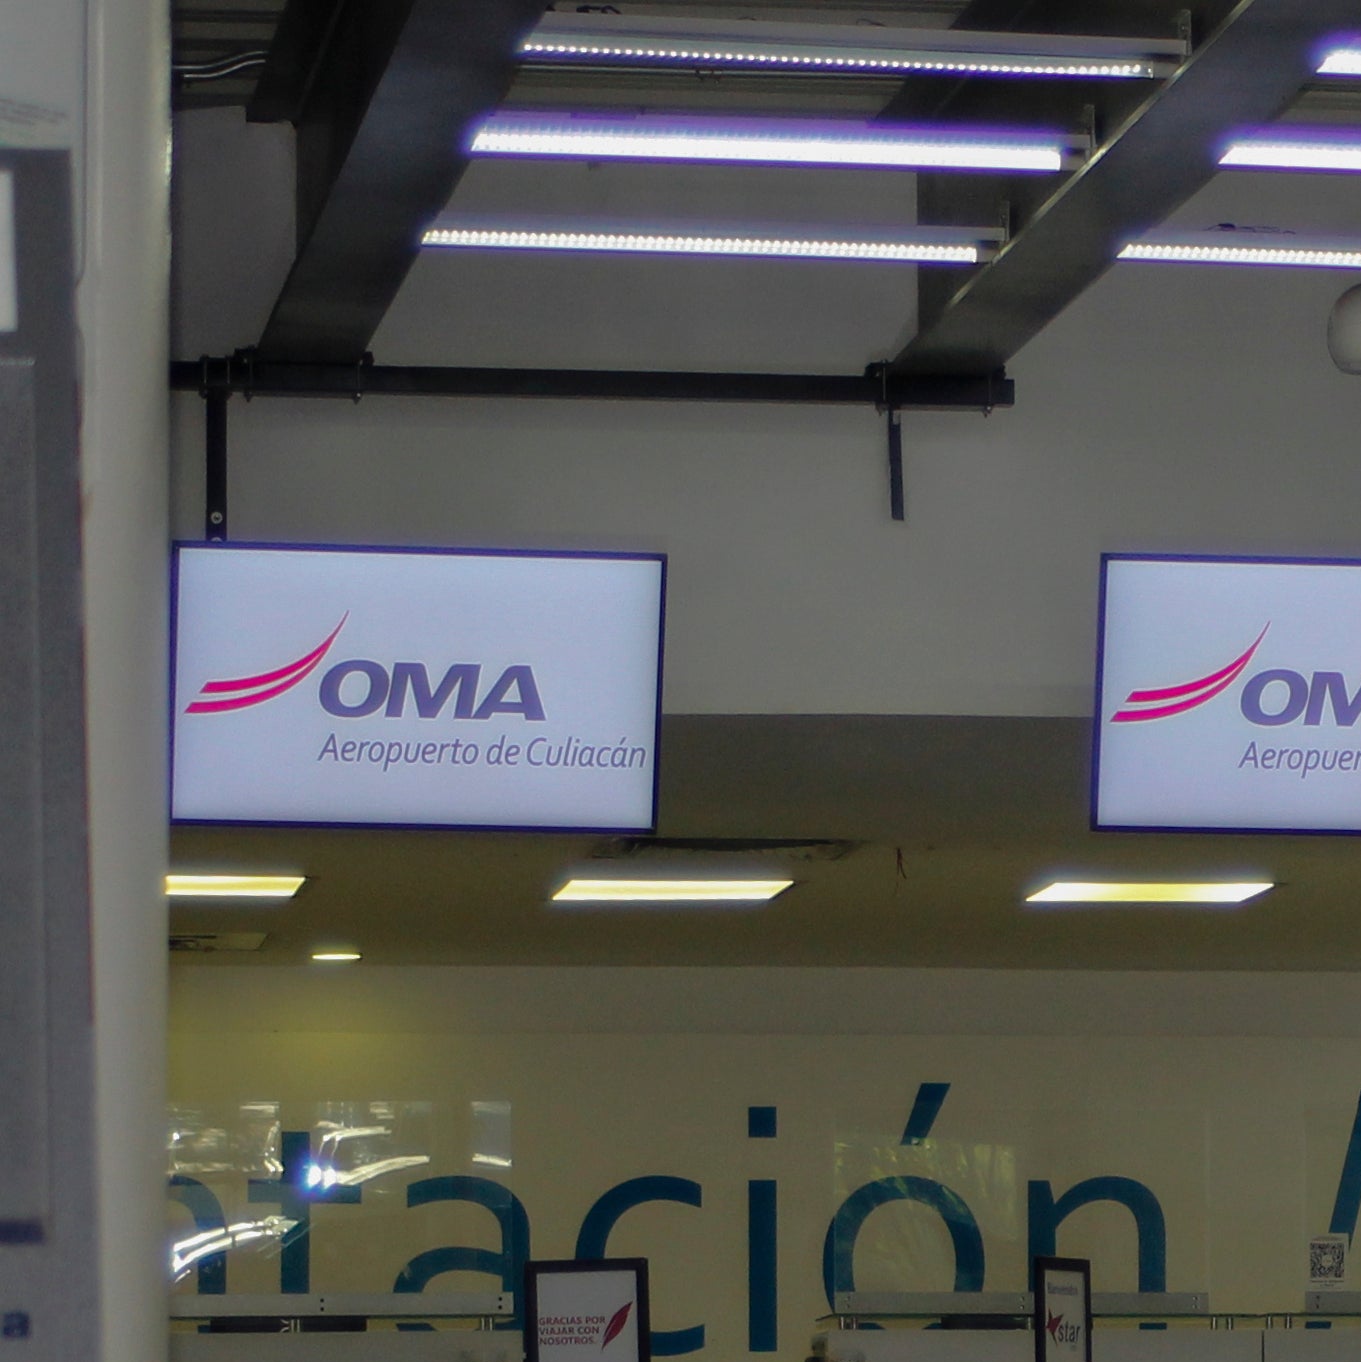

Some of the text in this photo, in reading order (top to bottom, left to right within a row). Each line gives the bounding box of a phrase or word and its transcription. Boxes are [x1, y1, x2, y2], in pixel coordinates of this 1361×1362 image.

[319, 660, 545, 720] OMA
[318, 734, 646, 771] Aeropuerto de Culiacán
[539, 1316, 605, 1325] GRACIAS POR
[539, 1327, 574, 1335] VIAJAR
[1057, 1319, 1081, 1343] star
